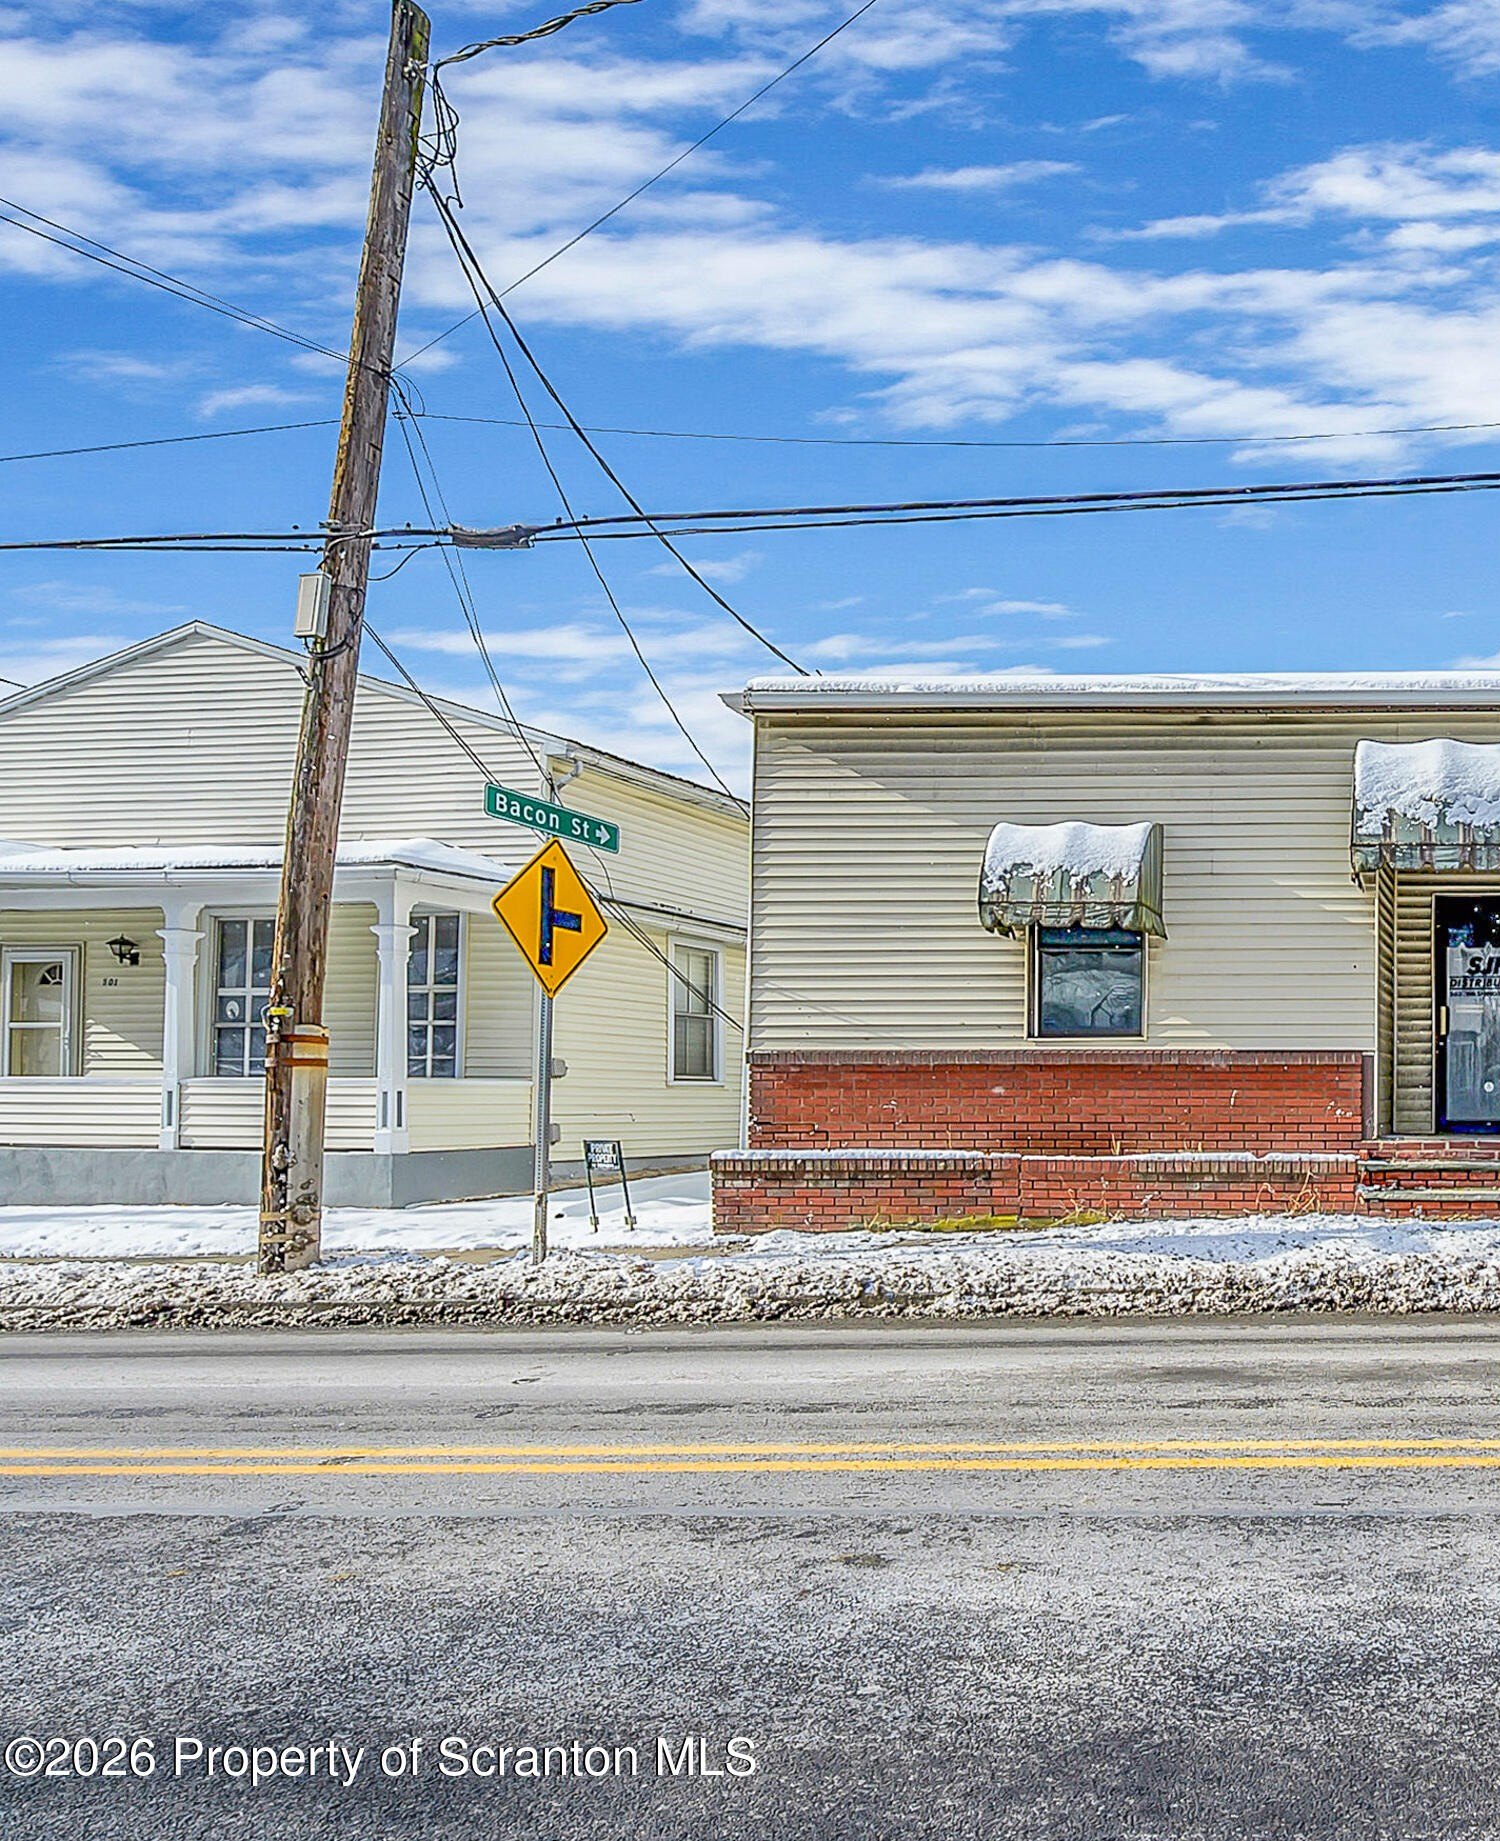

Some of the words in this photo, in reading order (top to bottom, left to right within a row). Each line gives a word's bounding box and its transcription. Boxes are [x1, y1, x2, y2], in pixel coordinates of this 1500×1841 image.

[495, 793, 560, 830] Bacon
[571, 818, 590, 839] St
[590, 1143, 614, 1154] PRIVATE
[587, 1152, 617, 1164] PROPERTY
